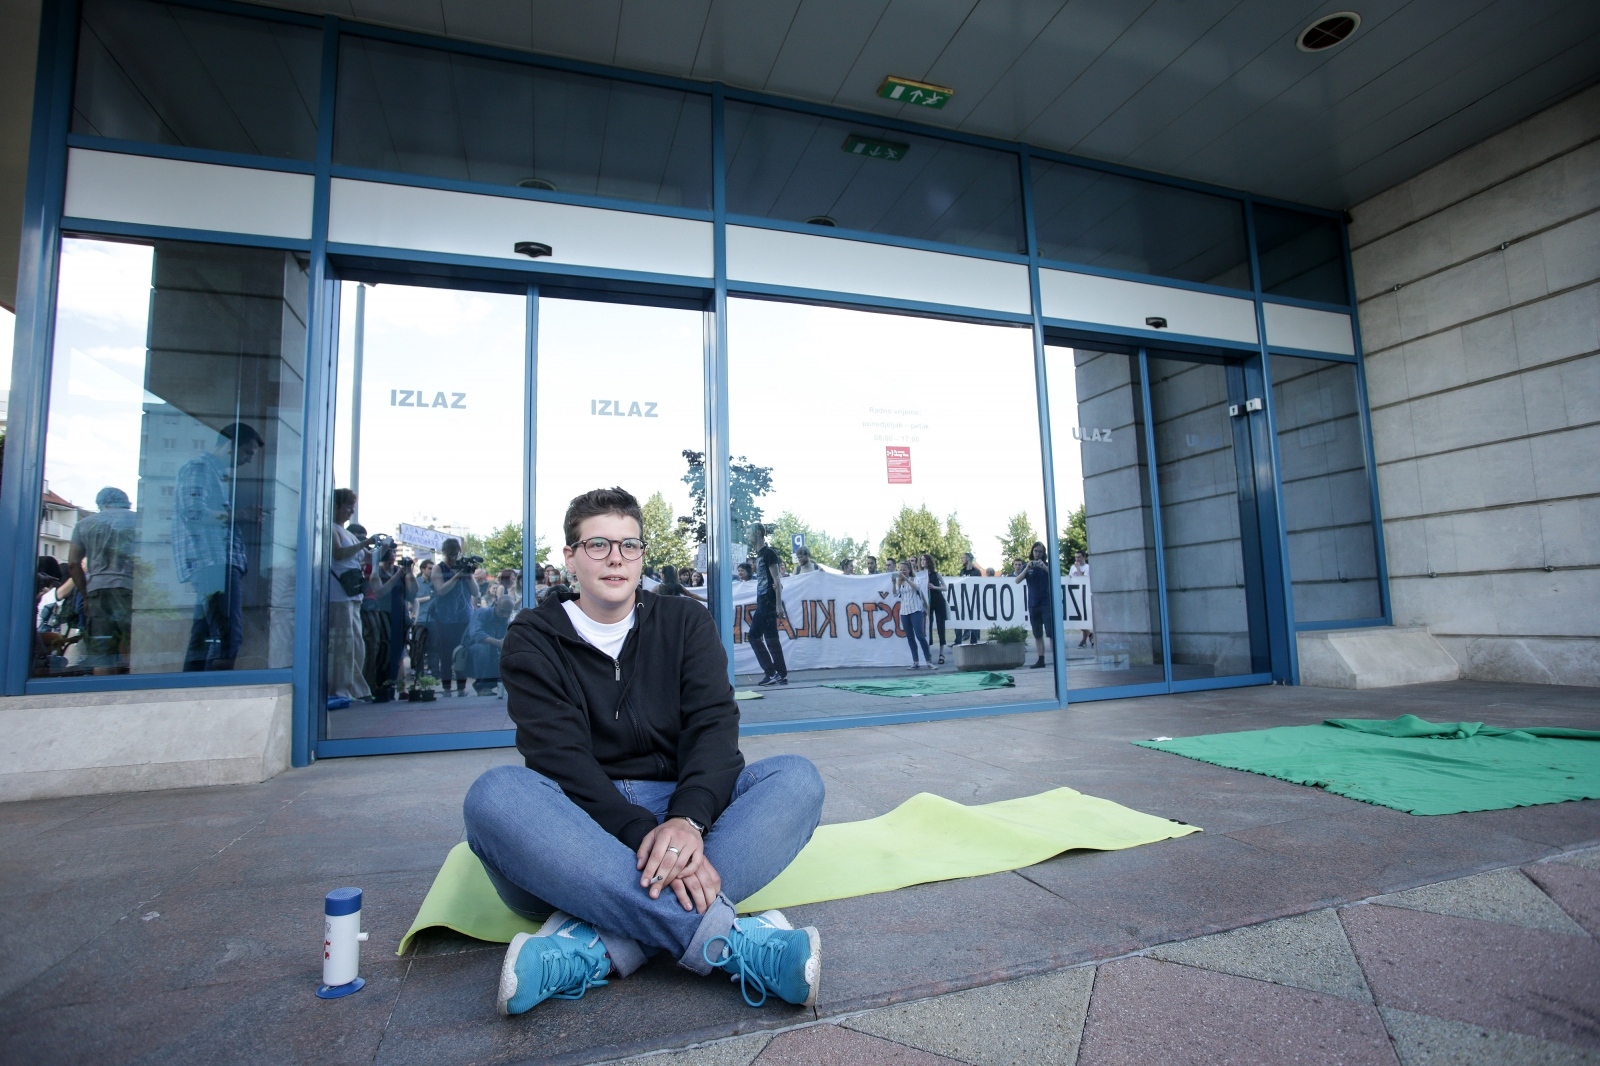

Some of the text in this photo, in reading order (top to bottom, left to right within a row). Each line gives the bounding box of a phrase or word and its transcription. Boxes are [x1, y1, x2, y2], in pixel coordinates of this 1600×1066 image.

[390, 389, 467, 409] IZLAZ
[591, 399, 659, 418] IZLAZ
[869, 406, 892, 414] Radno
[862, 421, 903, 429] ponedjeljak
[1071, 426, 1113, 443] ULAZ
